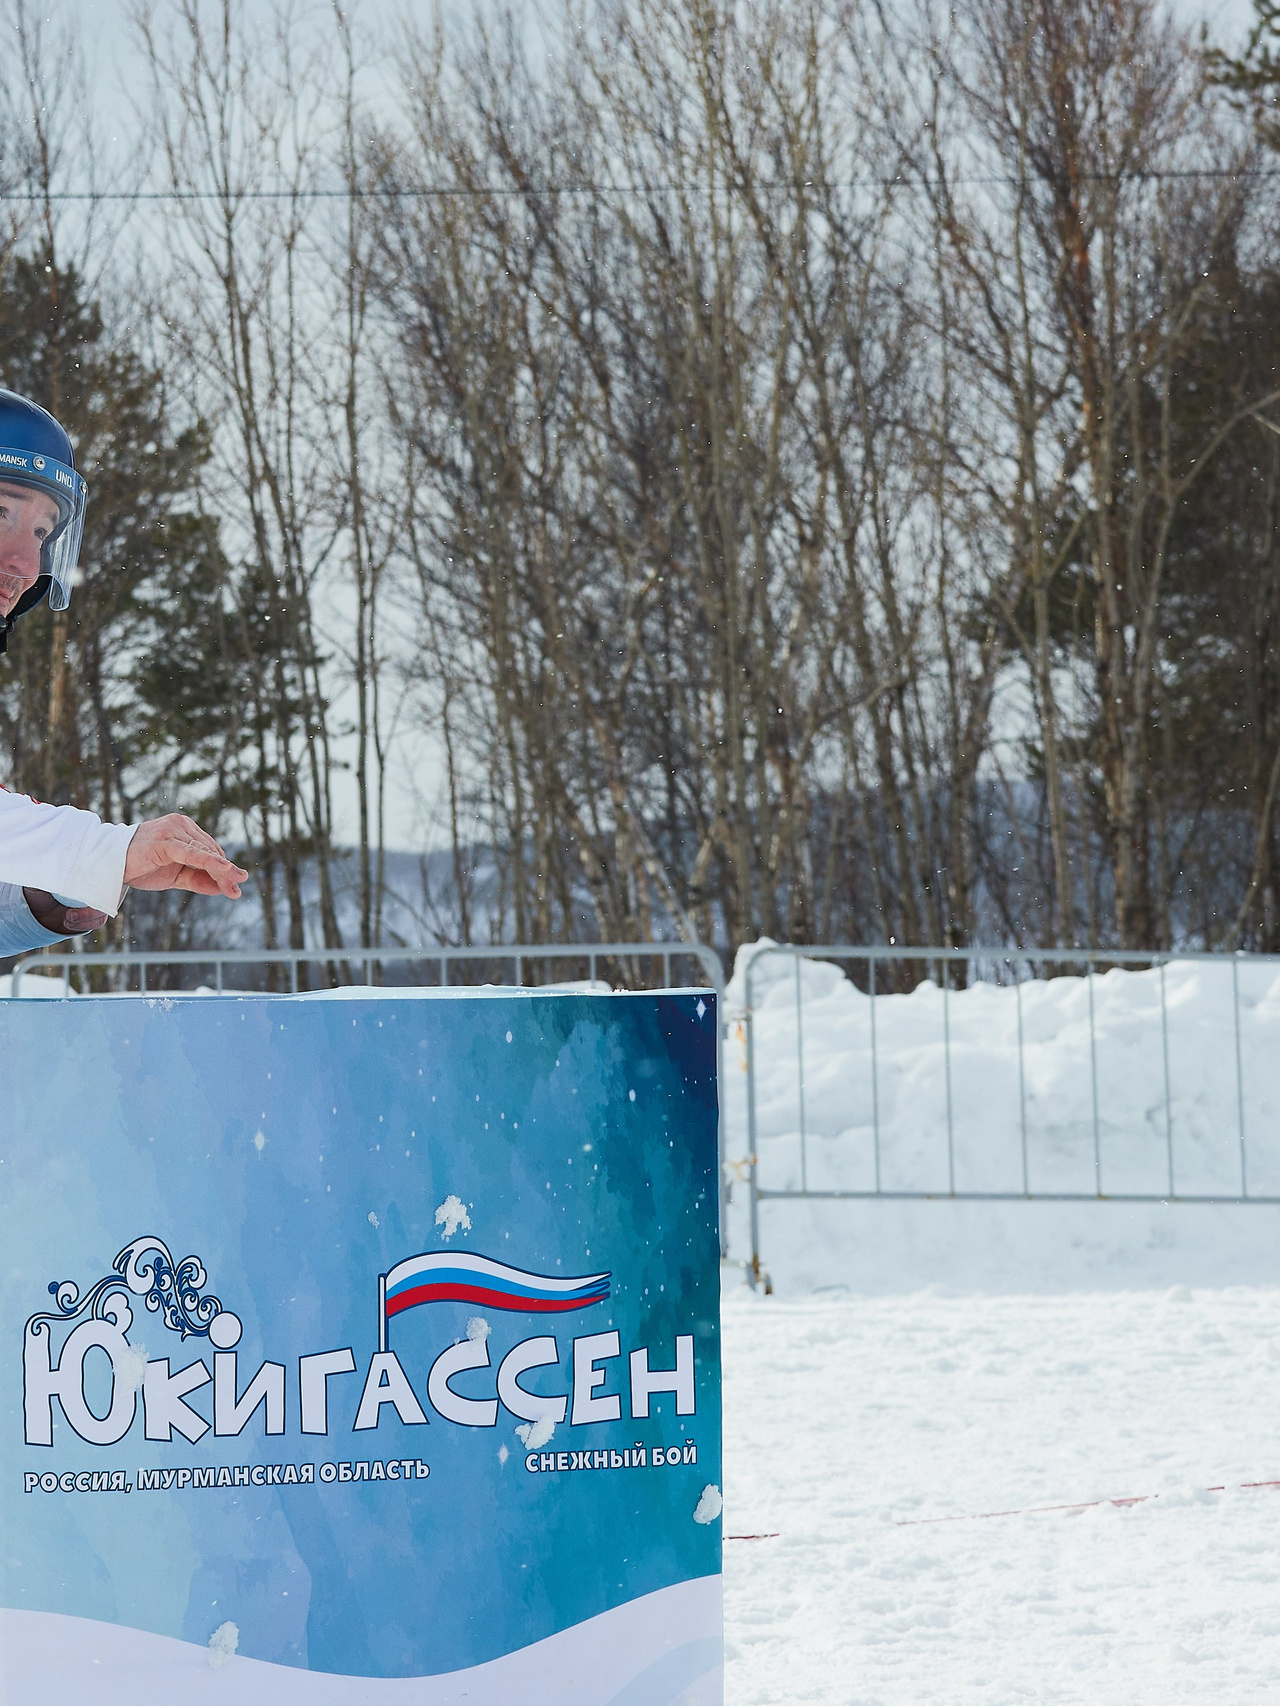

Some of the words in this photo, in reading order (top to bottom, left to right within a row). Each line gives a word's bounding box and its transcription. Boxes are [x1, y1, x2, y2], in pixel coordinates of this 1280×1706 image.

[525, 1441, 647, 1474] СНЕЖНЫЙ
[651, 1438, 698, 1467] БОЙ
[23, 1470, 133, 1494] РОССИЯ,
[136, 1462, 315, 1491] МУРМАНСКАЯ
[319, 1458, 431, 1484] ОБЛАСТЬ
